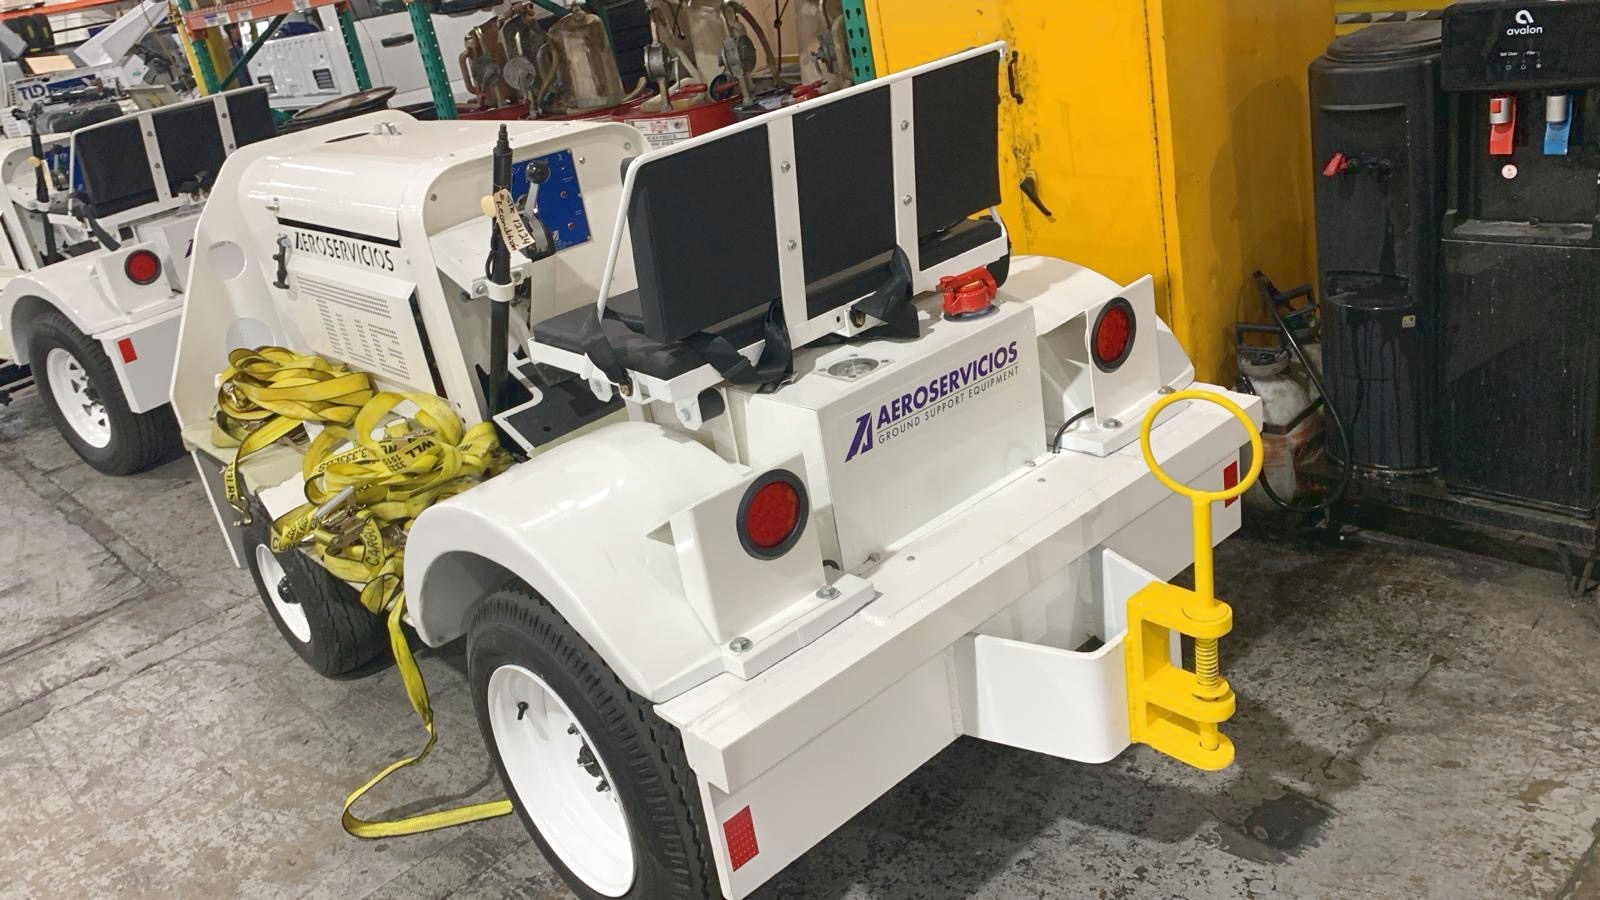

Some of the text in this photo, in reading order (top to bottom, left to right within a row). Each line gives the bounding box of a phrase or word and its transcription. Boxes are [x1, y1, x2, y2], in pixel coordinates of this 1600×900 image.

[1506, 25, 1543, 36] avalon
[18, 84, 46, 100] TLD
[512, 219, 531, 245] 12124
[294, 231, 395, 272] AEROSERVICIOS
[876, 341, 1019, 430] AEROSERVICIOS
[878, 366, 1020, 445] GROUND SUPPORT EQUIPMENT
[405, 439, 436, 459] WLL
